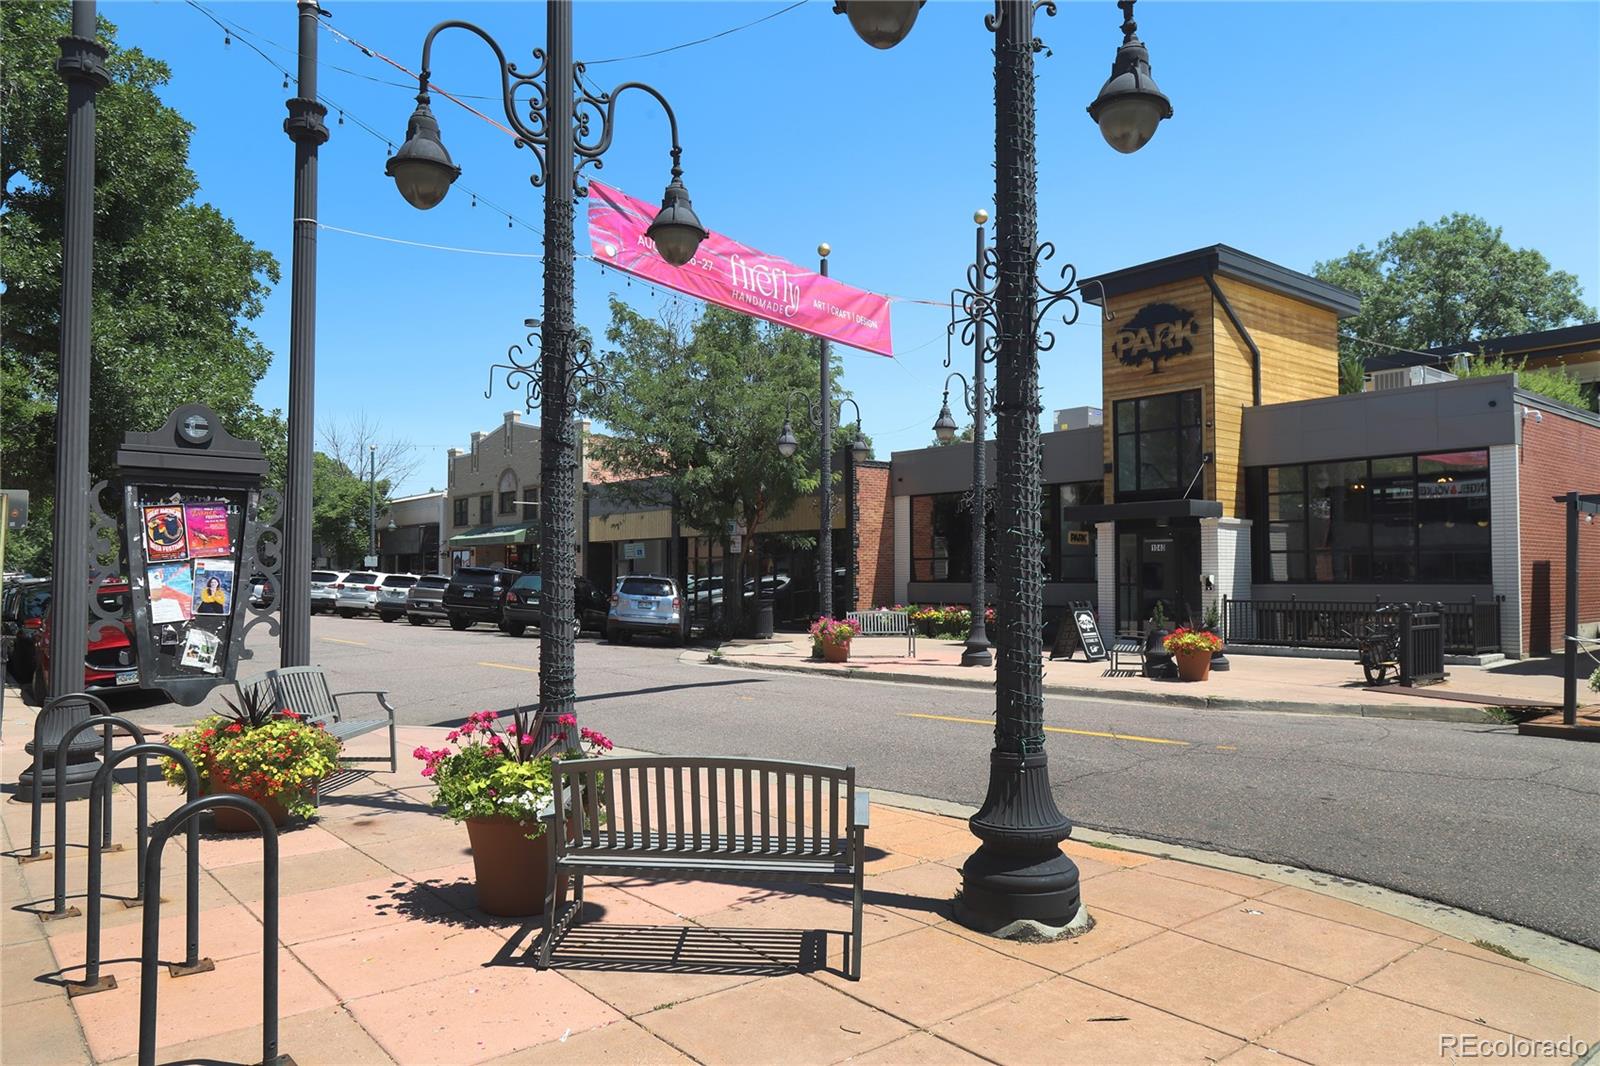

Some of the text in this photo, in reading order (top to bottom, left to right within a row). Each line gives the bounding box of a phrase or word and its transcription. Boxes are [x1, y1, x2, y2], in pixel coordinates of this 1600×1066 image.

[687, 255, 713, 271] 6-27
[730, 253, 800, 318] firefly
[731, 289, 784, 314] HANDMADE
[813, 299, 826, 311] ART
[830, 305, 851, 319] CRAFT
[856, 313, 878, 329] DESIGN
[1116, 319, 1198, 358] PARK
[1070, 532, 1088, 544] PARK
